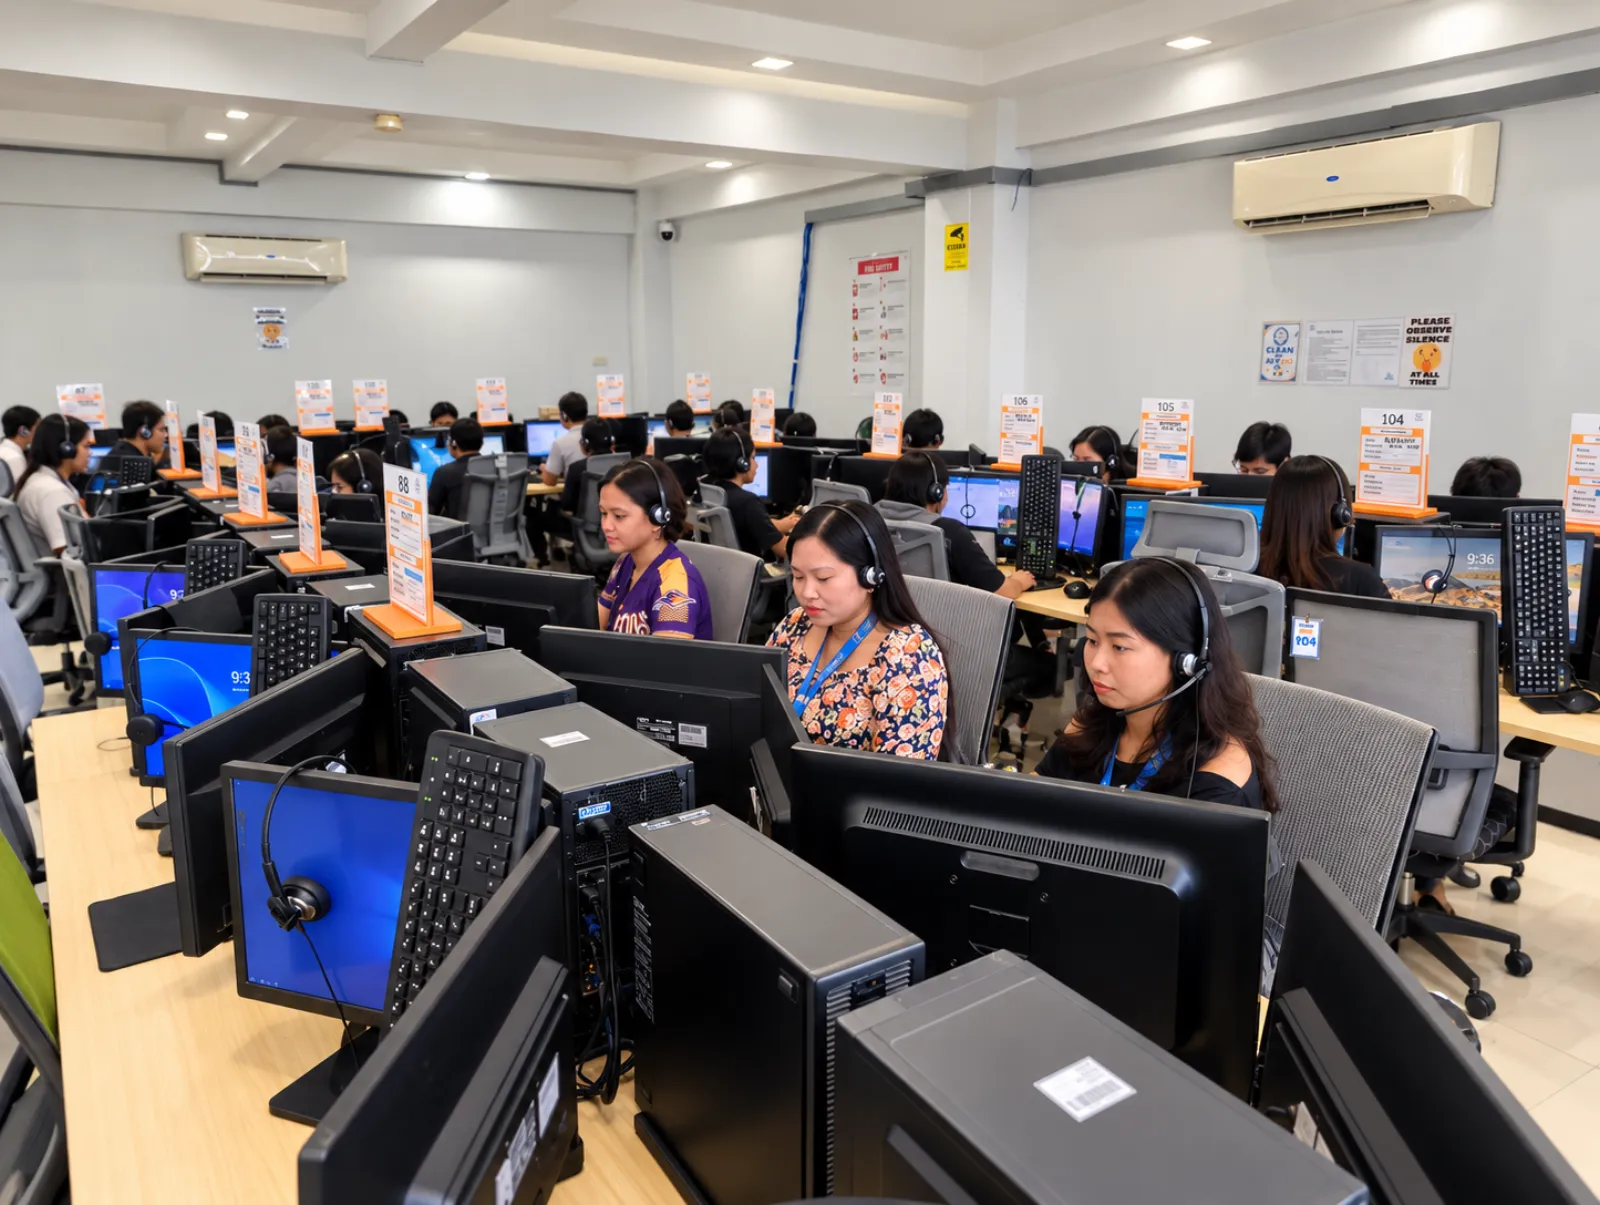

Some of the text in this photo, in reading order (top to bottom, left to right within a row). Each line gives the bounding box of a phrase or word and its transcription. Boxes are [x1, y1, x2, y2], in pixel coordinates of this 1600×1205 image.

[1410, 317, 1451, 326] PLEASE
[1406, 326, 1453, 335] OBSERVE
[1405, 335, 1450, 344] SILENCE
[1013, 396, 1028, 406] 106
[1157, 401, 1175, 412] 105
[1382, 413, 1405, 426] 104
[398, 475, 410, 494] 88
[1466, 553, 1495, 565] 9:36
[231, 671, 251, 685] 9:3
